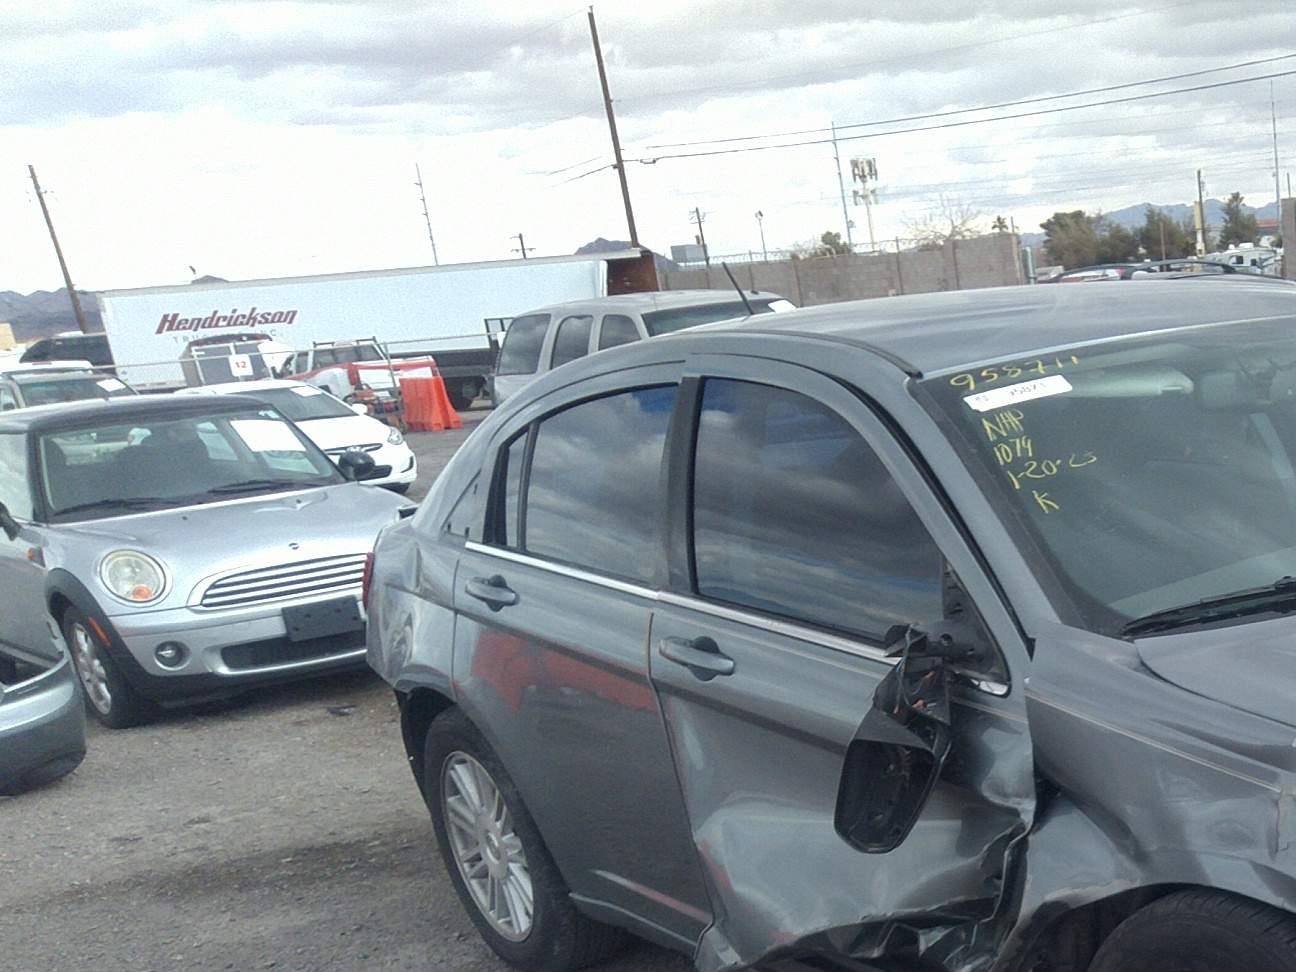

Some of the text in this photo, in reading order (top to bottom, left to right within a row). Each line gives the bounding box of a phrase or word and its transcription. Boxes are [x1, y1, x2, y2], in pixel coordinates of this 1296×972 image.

[155, 307, 298, 335] Hendrickson
[235, 360, 247, 369] 12
[950, 355, 1080, 391] 958711
[1032, 490, 1060, 514] K
